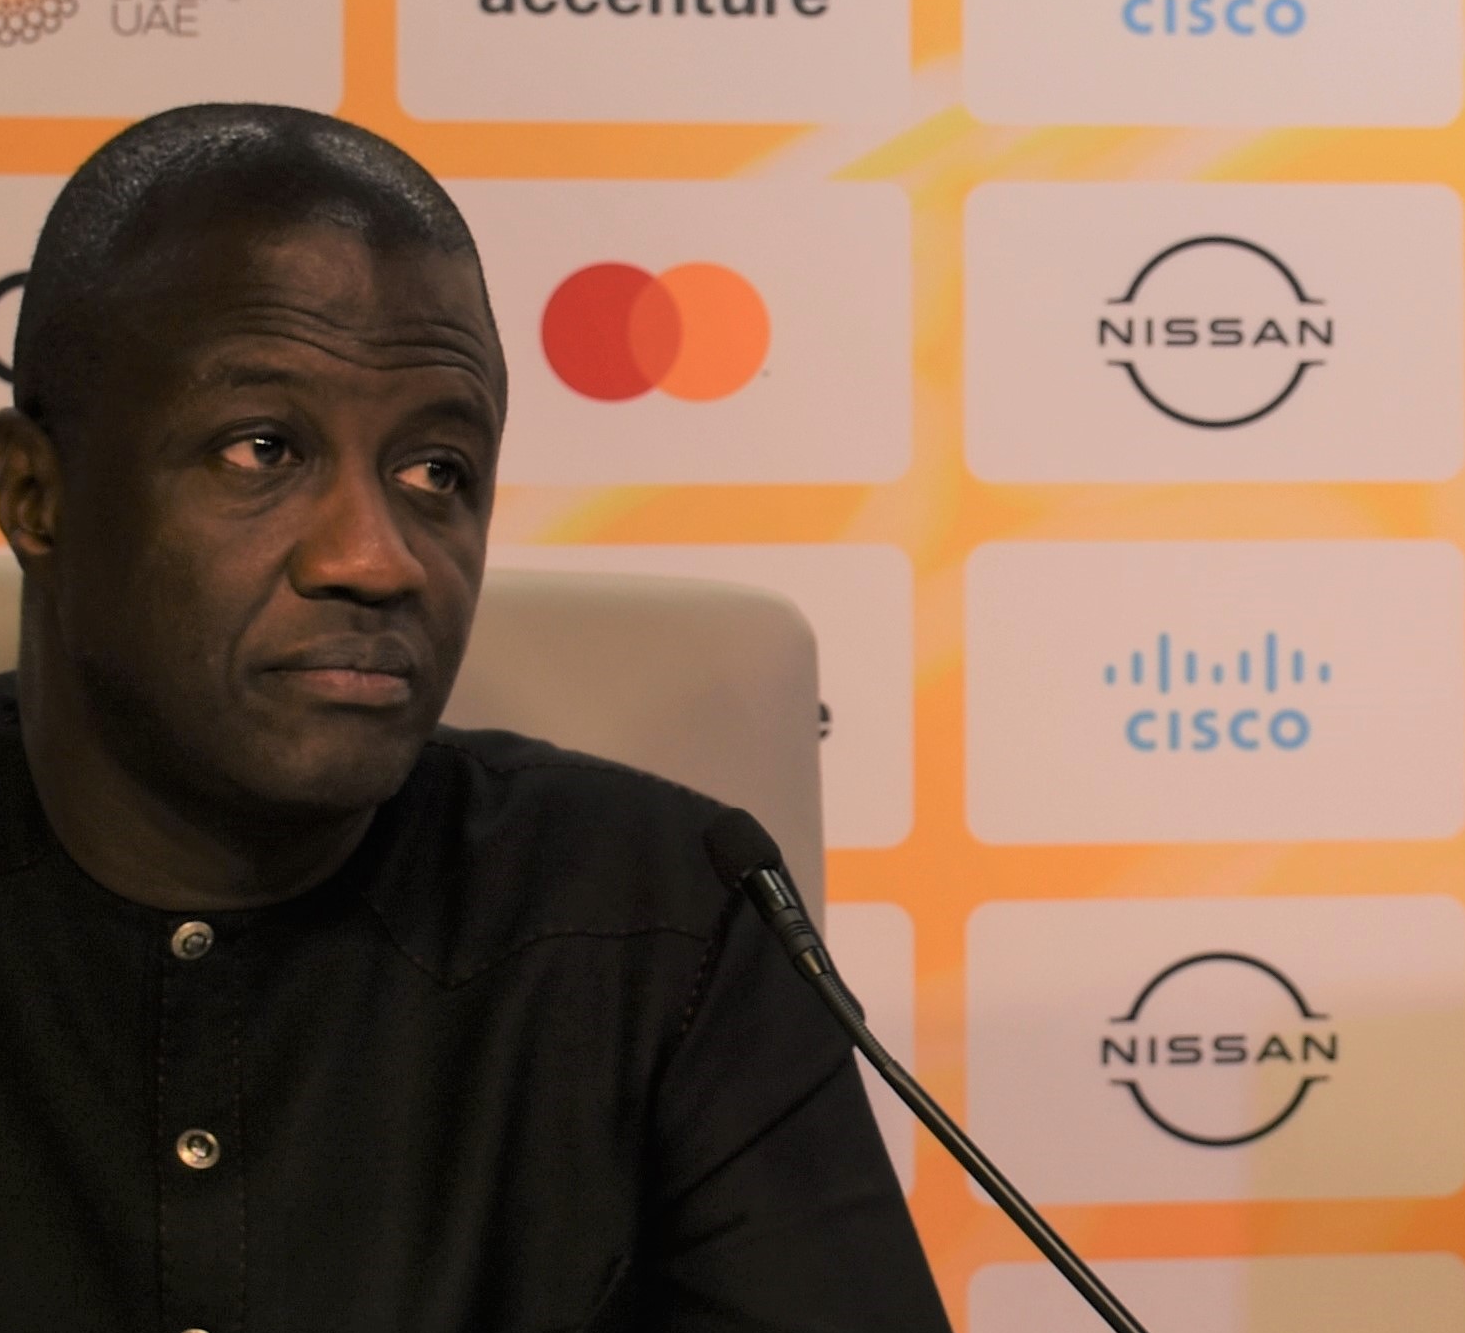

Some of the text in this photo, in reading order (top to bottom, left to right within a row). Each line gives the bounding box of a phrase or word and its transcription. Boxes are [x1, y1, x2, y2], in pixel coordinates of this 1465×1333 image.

[111, 3, 196, 37] UAE
[1099, 318, 1333, 346] NISSAN
[1125, 709, 1310, 752] CISCO
[1101, 1034, 1337, 1065] NISSAN
